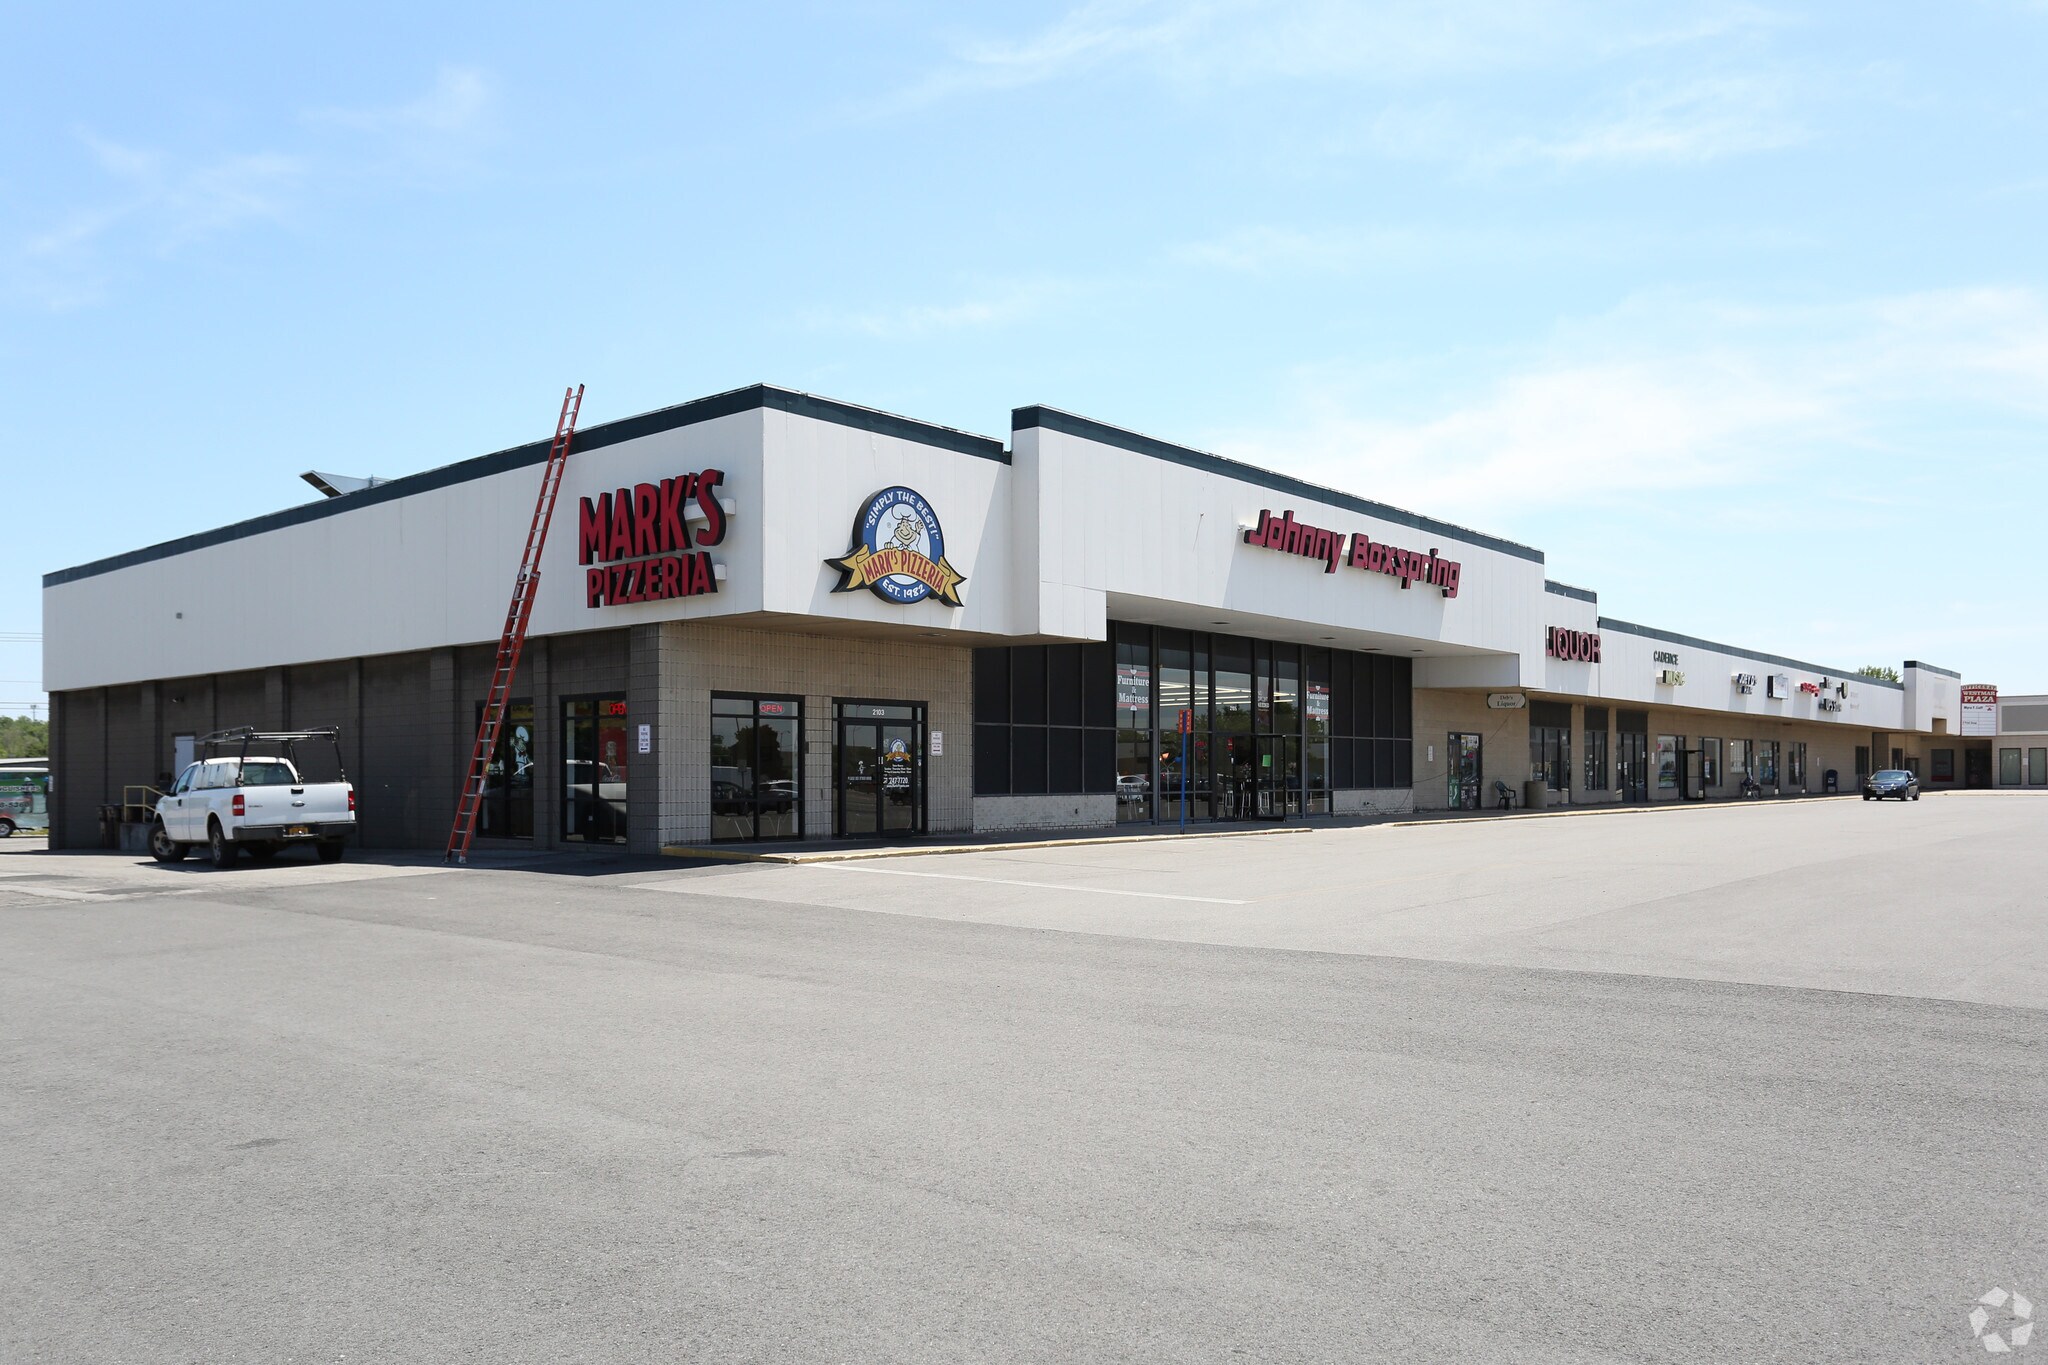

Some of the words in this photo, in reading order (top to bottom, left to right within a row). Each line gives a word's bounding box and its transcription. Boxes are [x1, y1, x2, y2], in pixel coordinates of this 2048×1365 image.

[896, 491, 916, 505] THE
[579, 469, 726, 566] MARK'S
[1244, 509, 1346, 574] Johnny
[1347, 533, 1462, 599] Boxspring
[862, 550, 898, 582] MARK'S
[900, 550, 945, 592] PIZZERIA
[586, 551, 717, 608] PIZZERIA
[882, 579, 901, 598] EST.
[903, 584, 926, 598] 1982
[1545, 625, 1602, 664] LIQUOR
[1117, 675, 1150, 687] Furniture
[1118, 692, 1149, 704] Mattress
[1306, 691, 1329, 701] Furniture
[760, 704, 784, 714] OPEN
[872, 708, 885, 716] 2103
[1306, 706, 1329, 715] Mattress
